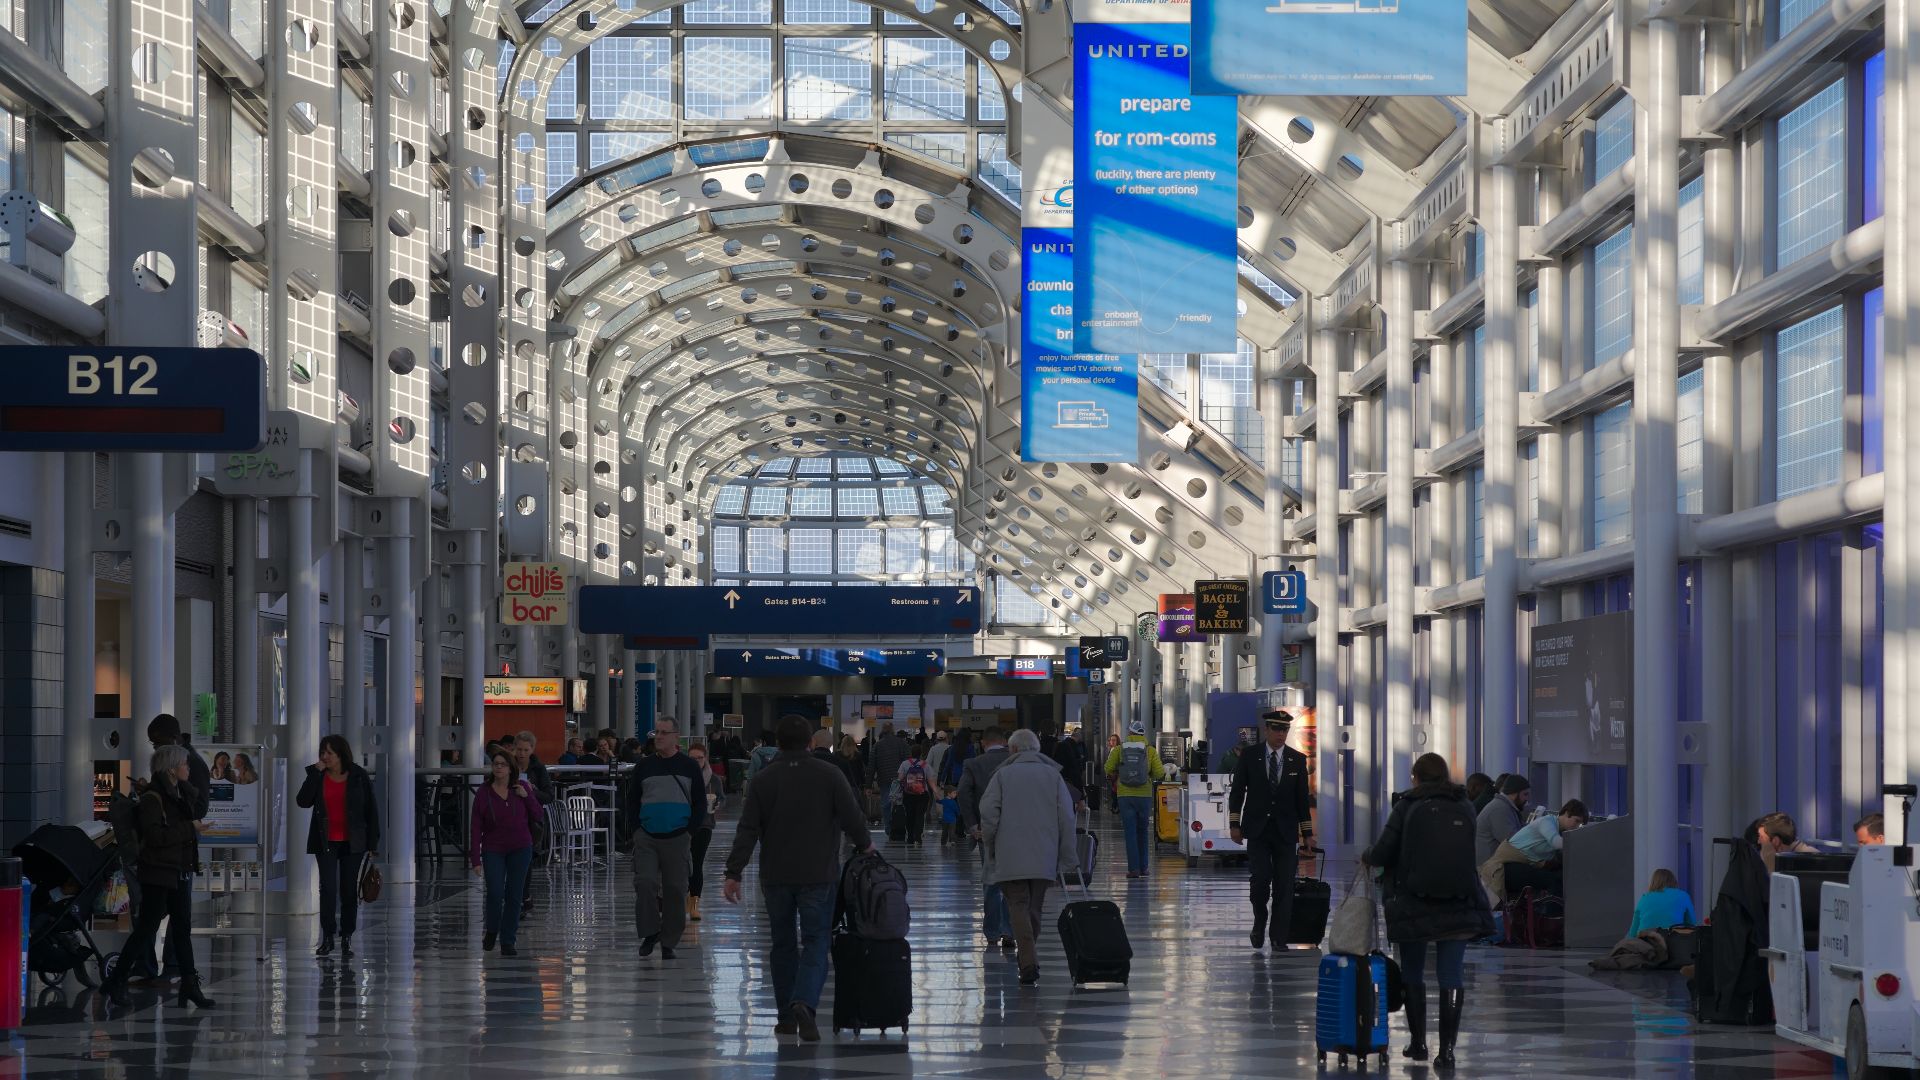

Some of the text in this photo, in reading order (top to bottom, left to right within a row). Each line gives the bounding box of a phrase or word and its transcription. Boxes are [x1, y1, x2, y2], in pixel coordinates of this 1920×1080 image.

[1088, 44, 1189, 58] UNITED
[1120, 97, 1191, 114] prepare
[1095, 130, 1216, 146] for rom-coms
[1095, 169, 1216, 182] (luckily, there are plenty
[1115, 184, 1198, 196] of other options)
[1050, 304, 1073, 316] cha
[1104, 311, 1138, 319] onboard
[1179, 313, 1211, 323] friendly
[1081, 319, 1138, 328] entertainment
[1039, 353, 1120, 363] enjoy hundreds of free
[1036, 365, 1062, 373] movies
[1063, 364, 1077, 373] and
[1078, 365, 1088, 373] TV
[1089, 364, 1112, 373] shows
[68, 355, 159, 395] B12
[1042, 376, 1116, 386] your personal device
[1222, 583, 1245, 592] AMERICAN
[764, 598, 789, 606] Gates
[1202, 594, 1241, 604] BAGEL
[512, 597, 558, 622] bar
[1199, 619, 1244, 629] BAKERY
[1015, 660, 1035, 668] B18
[890, 678, 907, 687] B17
[1823, 936, 1843, 951] UNITED
